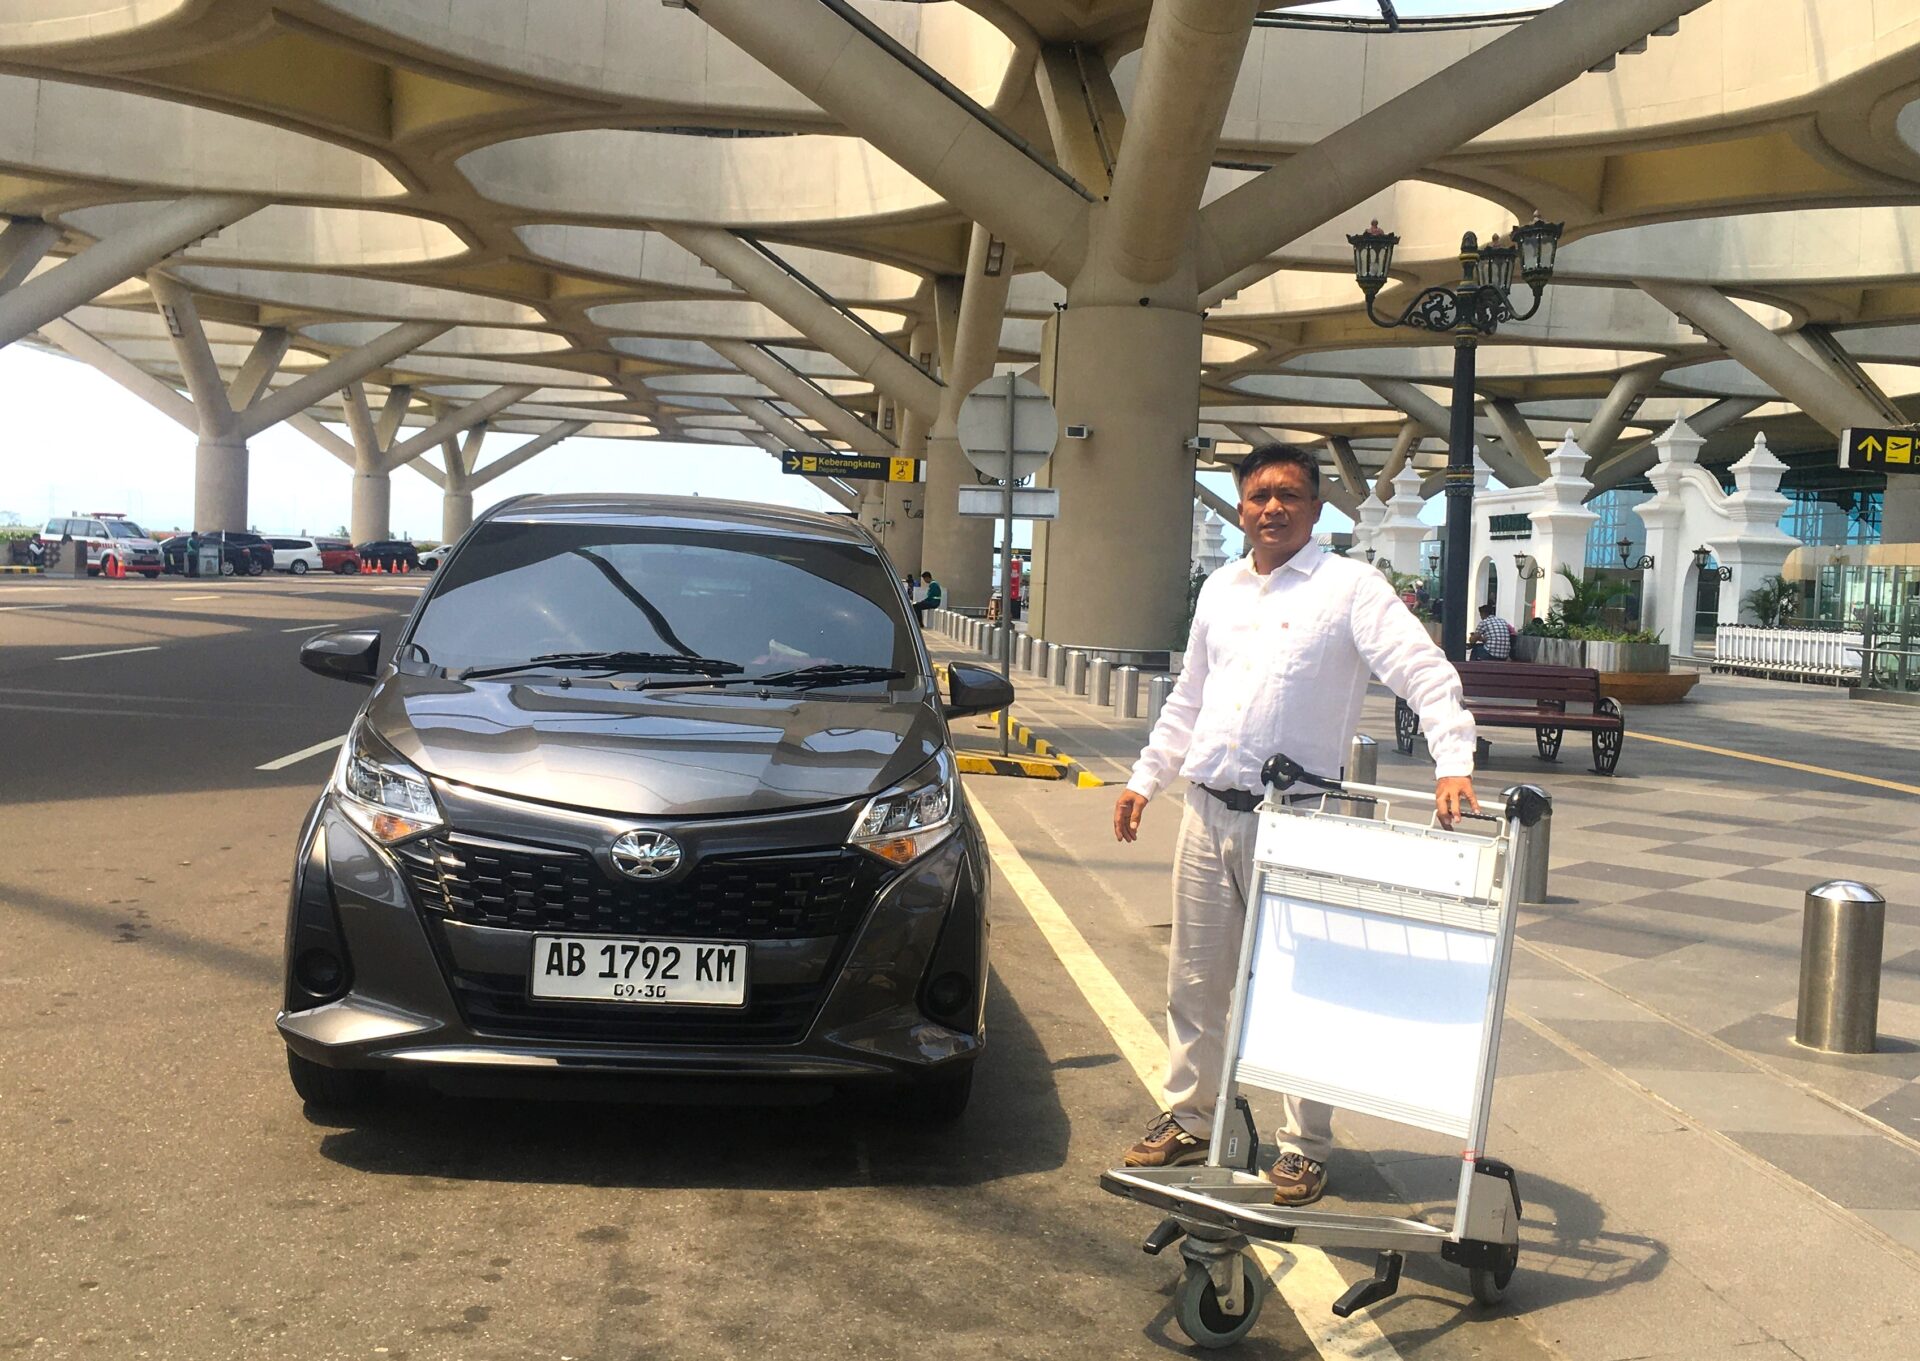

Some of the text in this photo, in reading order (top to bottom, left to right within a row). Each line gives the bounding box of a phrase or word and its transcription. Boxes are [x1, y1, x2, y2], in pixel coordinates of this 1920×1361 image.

[818, 457, 881, 469] Keberangkatan
[545, 942, 736, 982] AB 1792 KM
